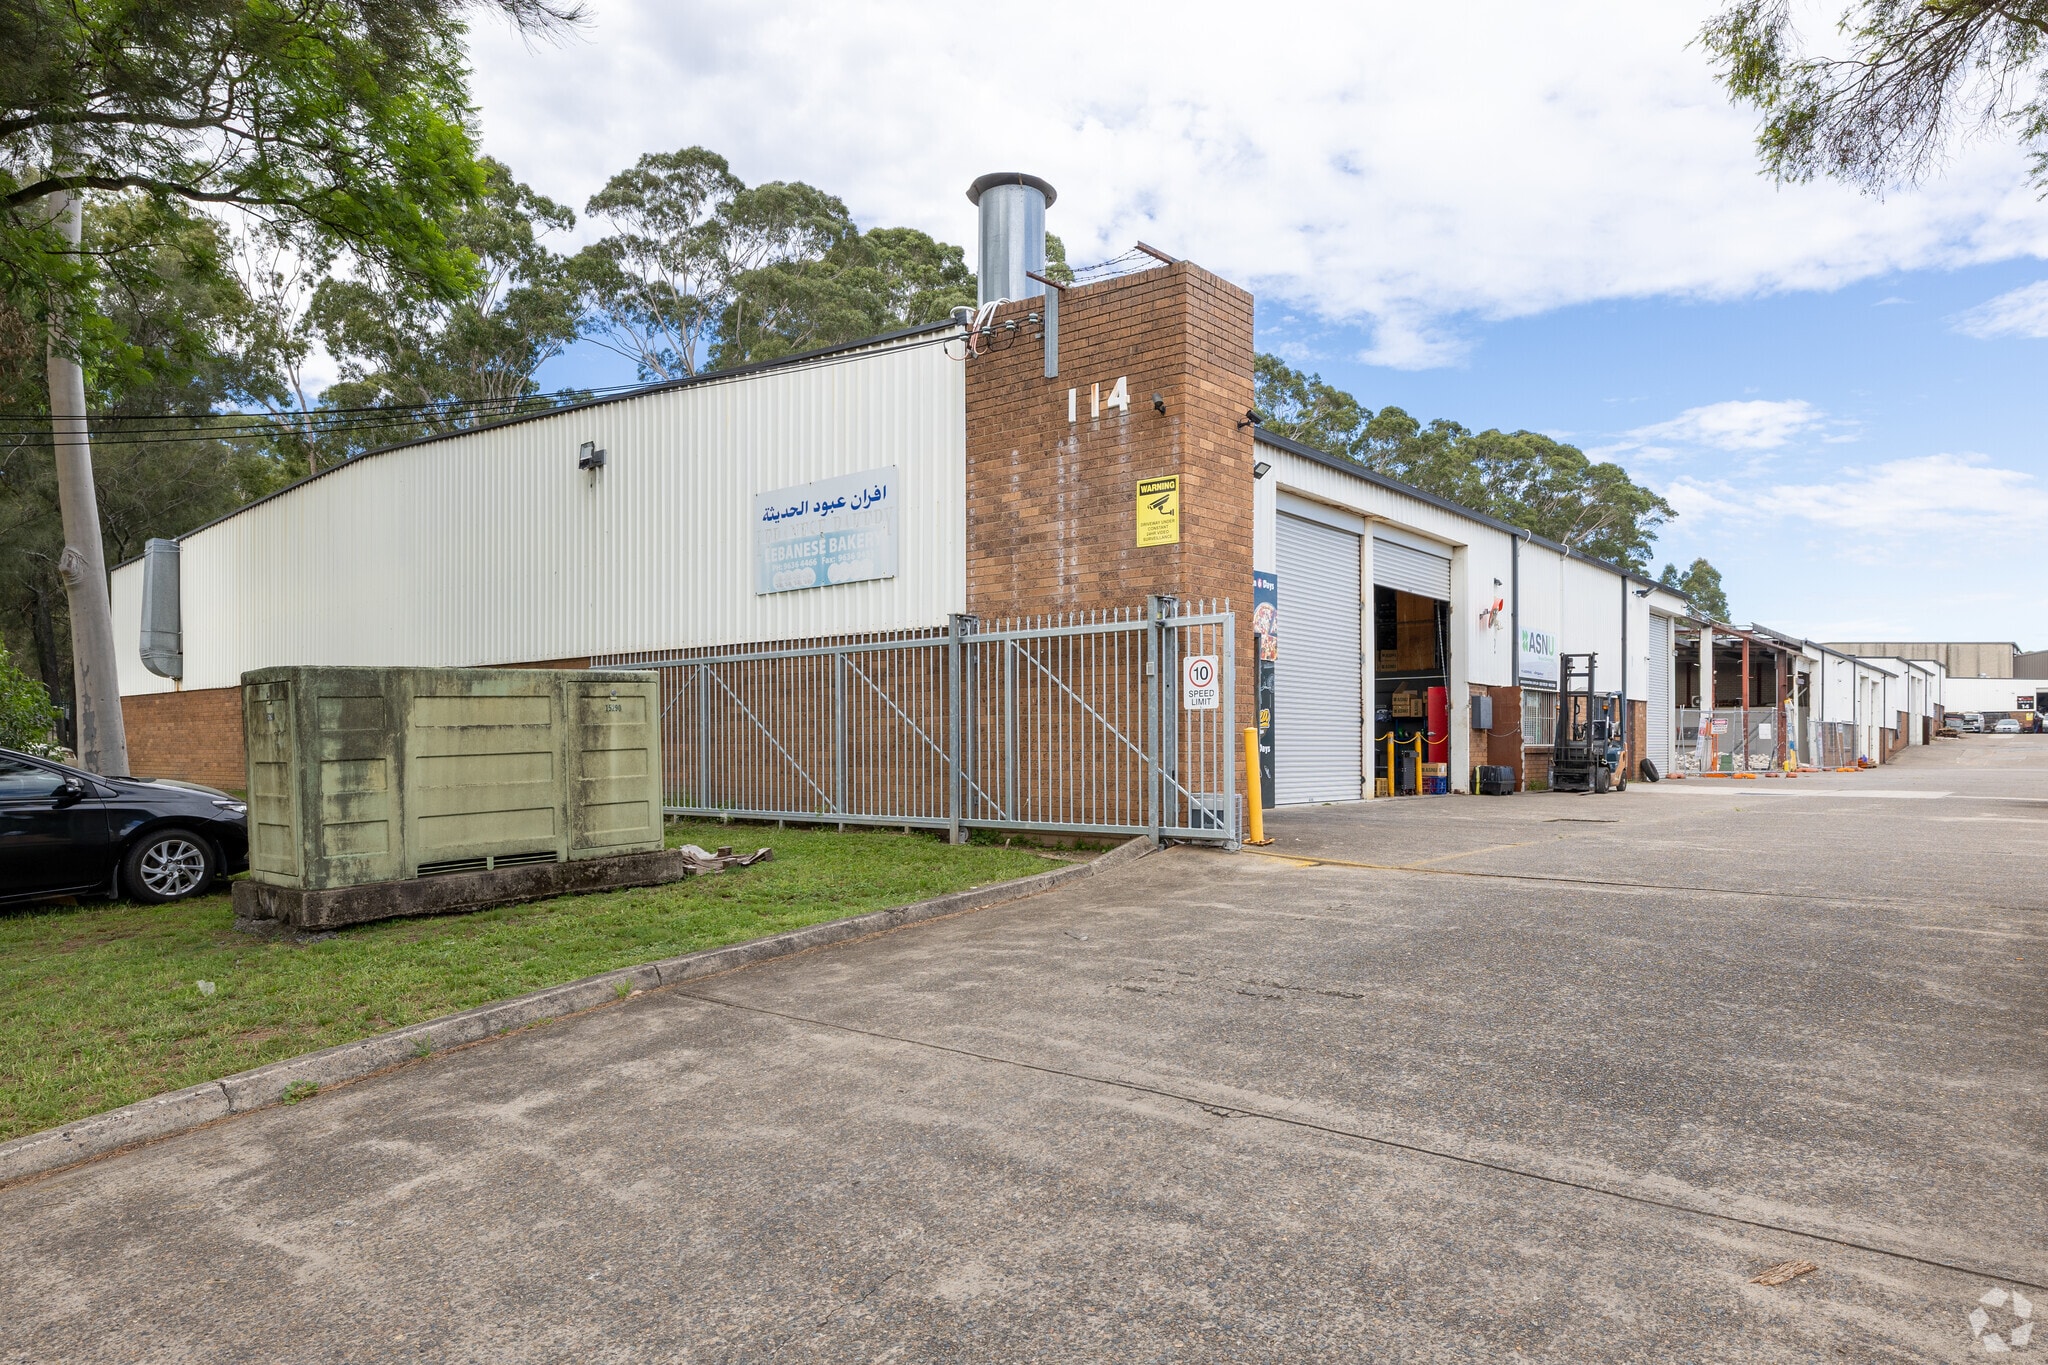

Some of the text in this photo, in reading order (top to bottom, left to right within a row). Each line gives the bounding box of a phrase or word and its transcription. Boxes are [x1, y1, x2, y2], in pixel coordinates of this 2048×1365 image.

[1068, 376, 1131, 423] 114
[1140, 480, 1175, 494] WARNING
[850, 484, 887, 510] افران
[762, 500, 809, 524] الحديثة
[813, 496, 847, 517] عبود
[1140, 518, 1176, 528] DRIVEWAY UNDER
[1147, 524, 1169, 532] CONSTANT
[1143, 533, 1173, 542] SURVEILLANCE
[764, 531, 880, 563] LEBANESE BAKERY
[821, 555, 836, 566] Fax:
[1262, 579, 1275, 591] Days
[1528, 631, 1555, 657] ASNU
[1193, 665, 1209, 681] 10
[1188, 689, 1215, 698] SPEED
[1191, 697, 1212, 706] LIMIT
